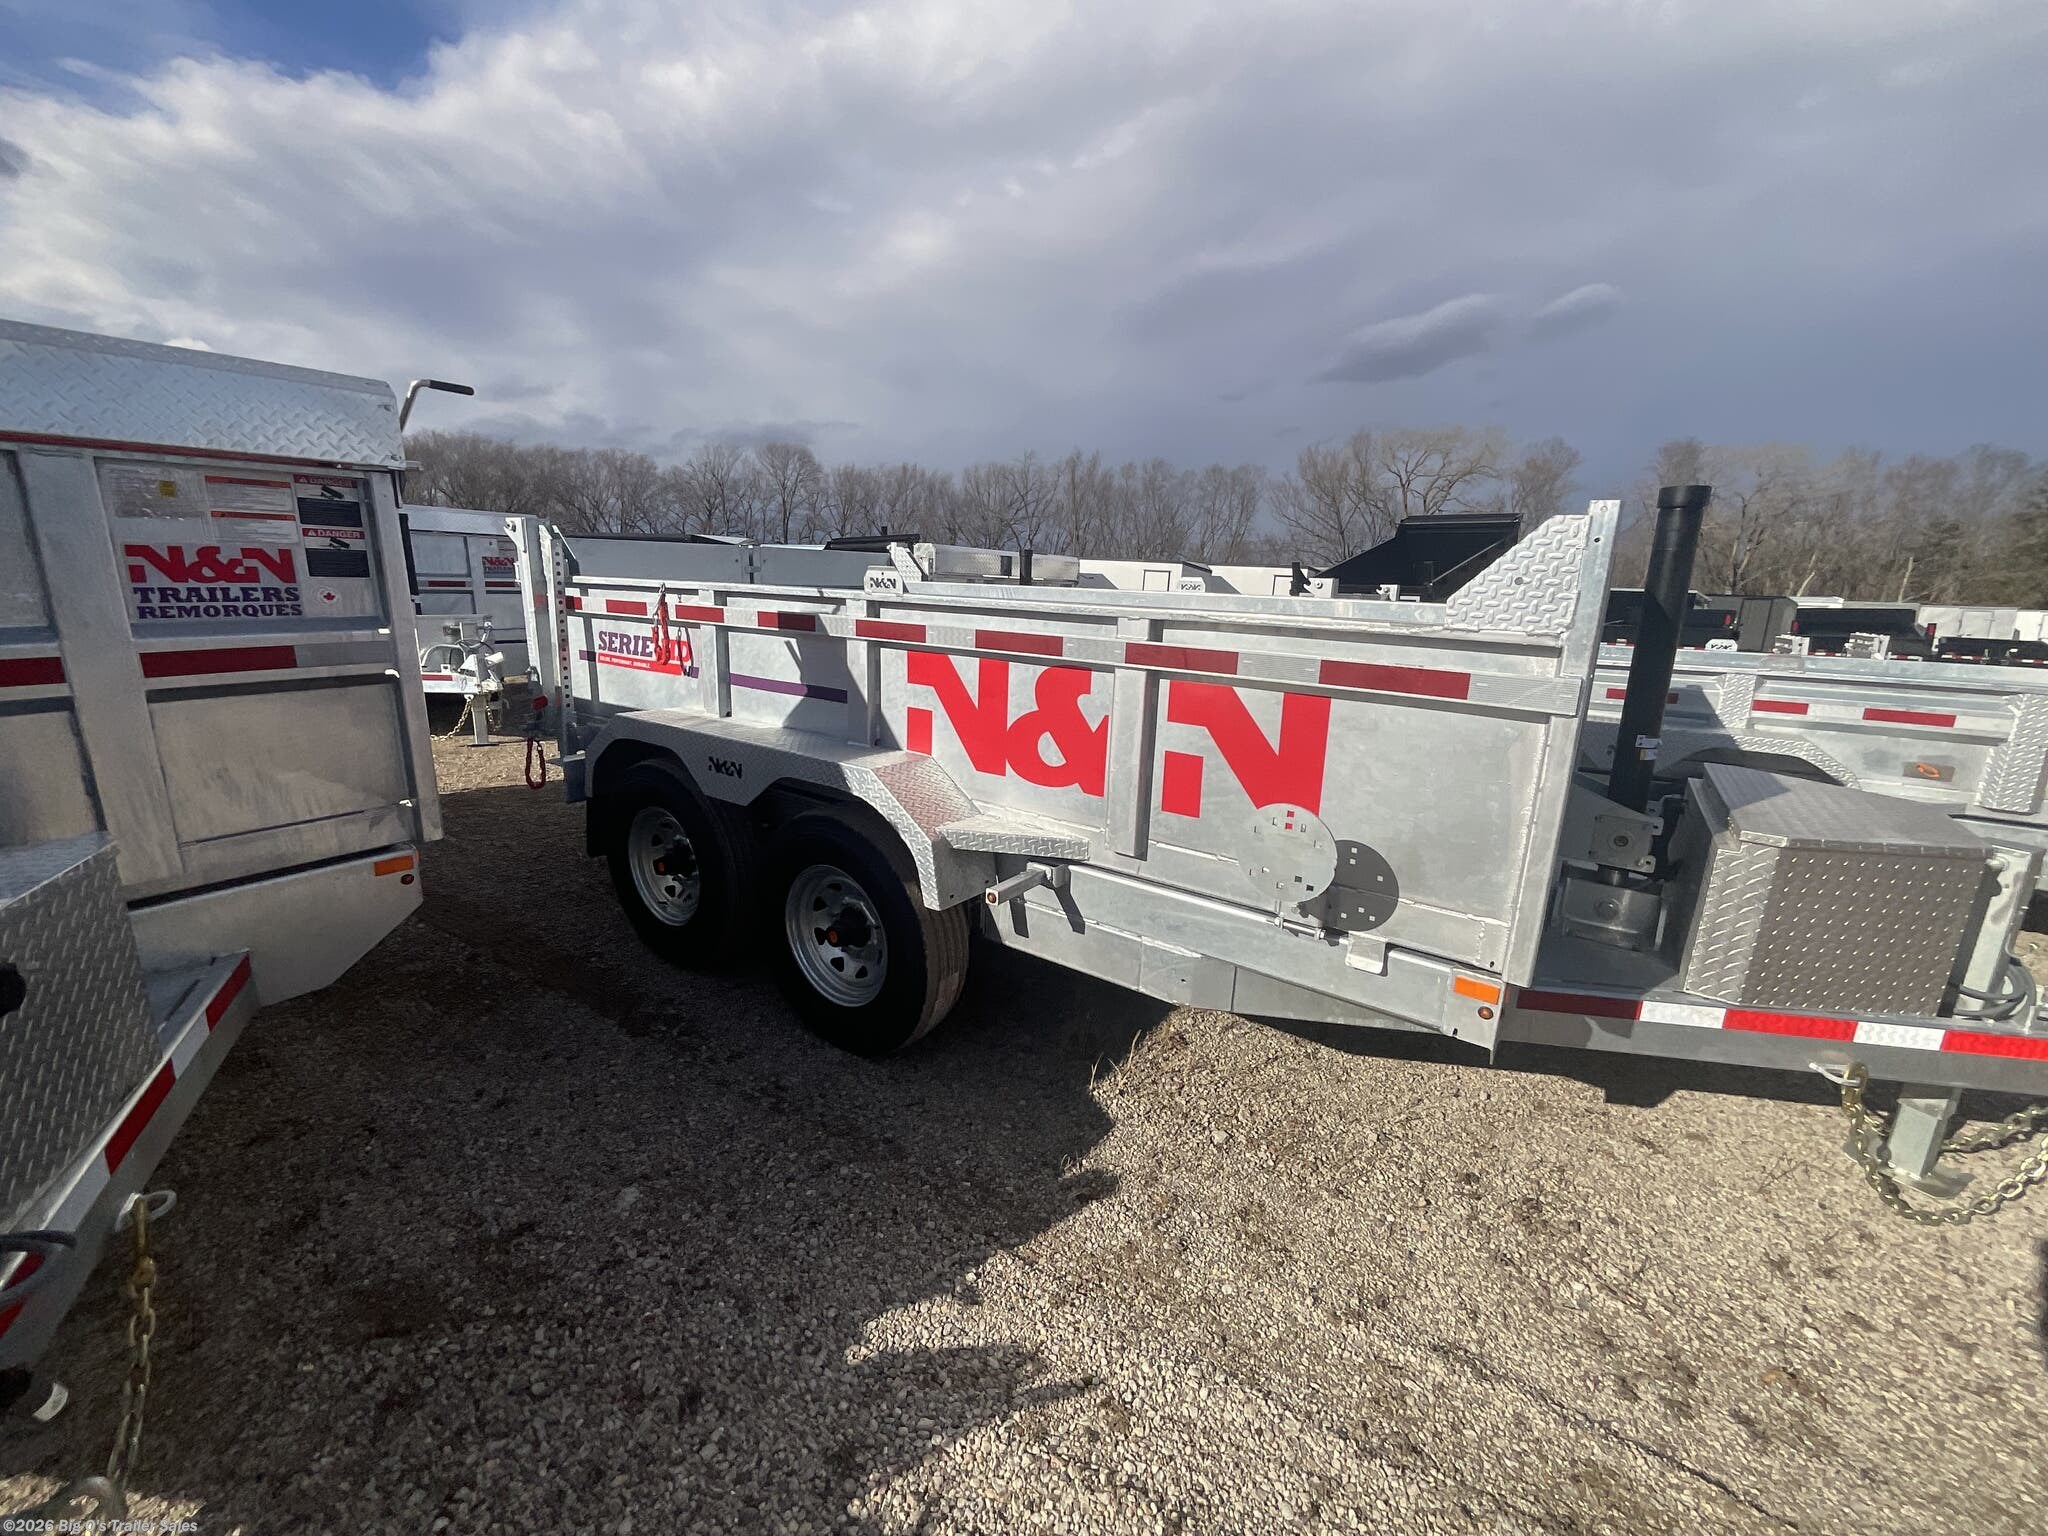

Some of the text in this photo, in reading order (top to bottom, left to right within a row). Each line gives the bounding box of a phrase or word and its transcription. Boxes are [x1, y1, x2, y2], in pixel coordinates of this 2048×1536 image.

[317, 530, 361, 539] DANGER
[124, 544, 297, 584] N&N
[869, 577, 897, 589] N&N
[133, 586, 301, 604] TRAILERS
[137, 603, 303, 620] REMORQUES
[598, 630, 654, 658] SERIE
[907, 650, 1332, 819] N&N
